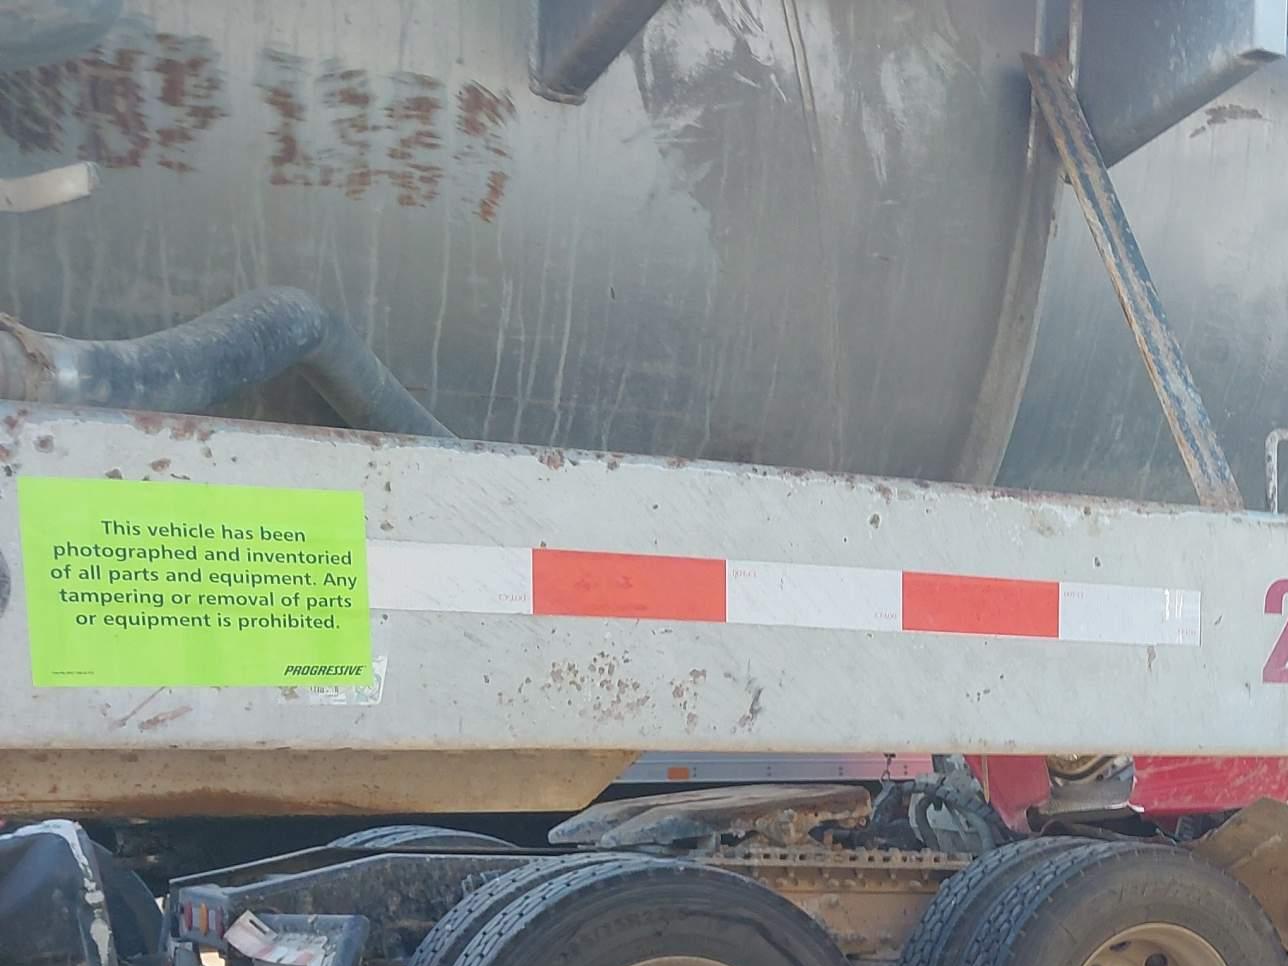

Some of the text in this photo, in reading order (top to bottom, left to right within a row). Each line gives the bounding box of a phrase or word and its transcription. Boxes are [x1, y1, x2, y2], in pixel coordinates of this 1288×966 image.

[101, 520, 306, 542] This vehicle has been
[53, 541, 352, 565] photographed and inventoried
[50, 564, 357, 591] of all parts and equipment. Any
[59, 588, 352, 611] tampering or removal of parts
[75, 611, 341, 631] or equipment is prohibited.
[284, 665, 364, 676] PROGRESSIVE
